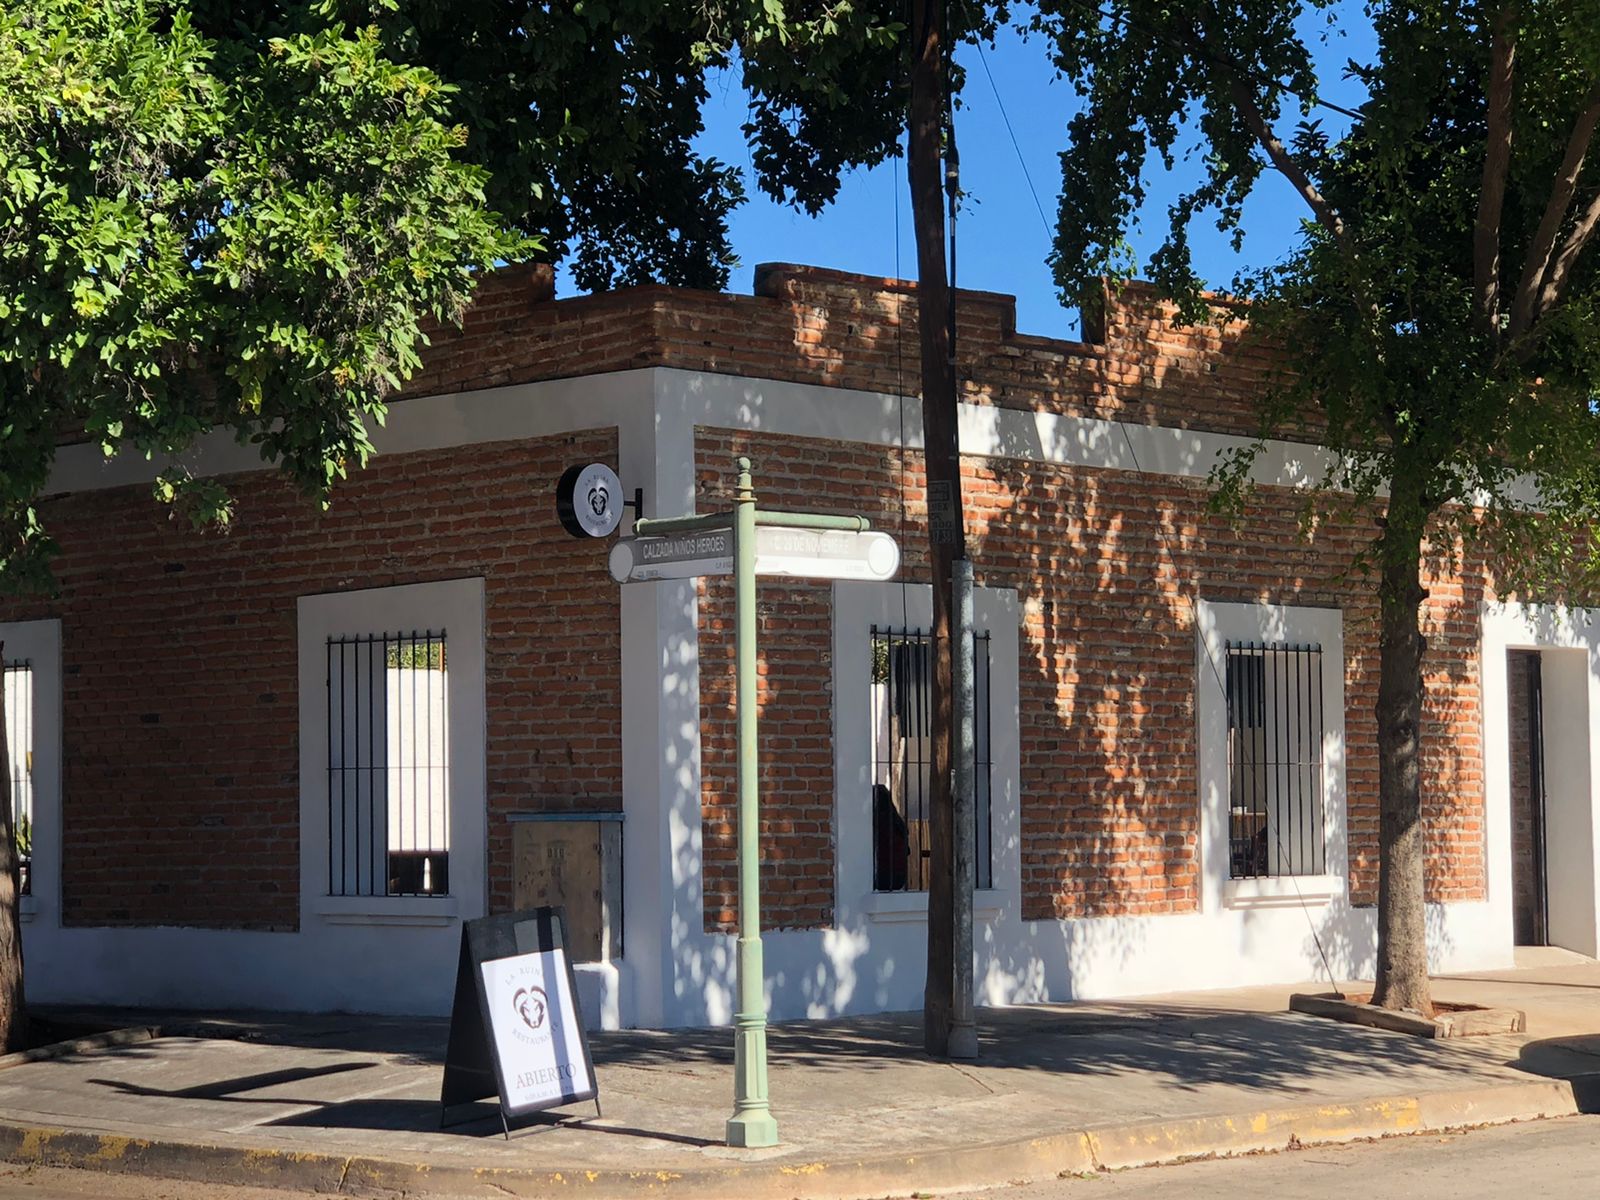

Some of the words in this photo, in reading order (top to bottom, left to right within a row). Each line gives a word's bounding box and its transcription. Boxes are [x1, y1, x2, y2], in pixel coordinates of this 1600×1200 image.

[642, 541, 673, 559] CALZADA
[696, 535, 726, 553] HEROES
[516, 1063, 577, 1090] ABIERTO
